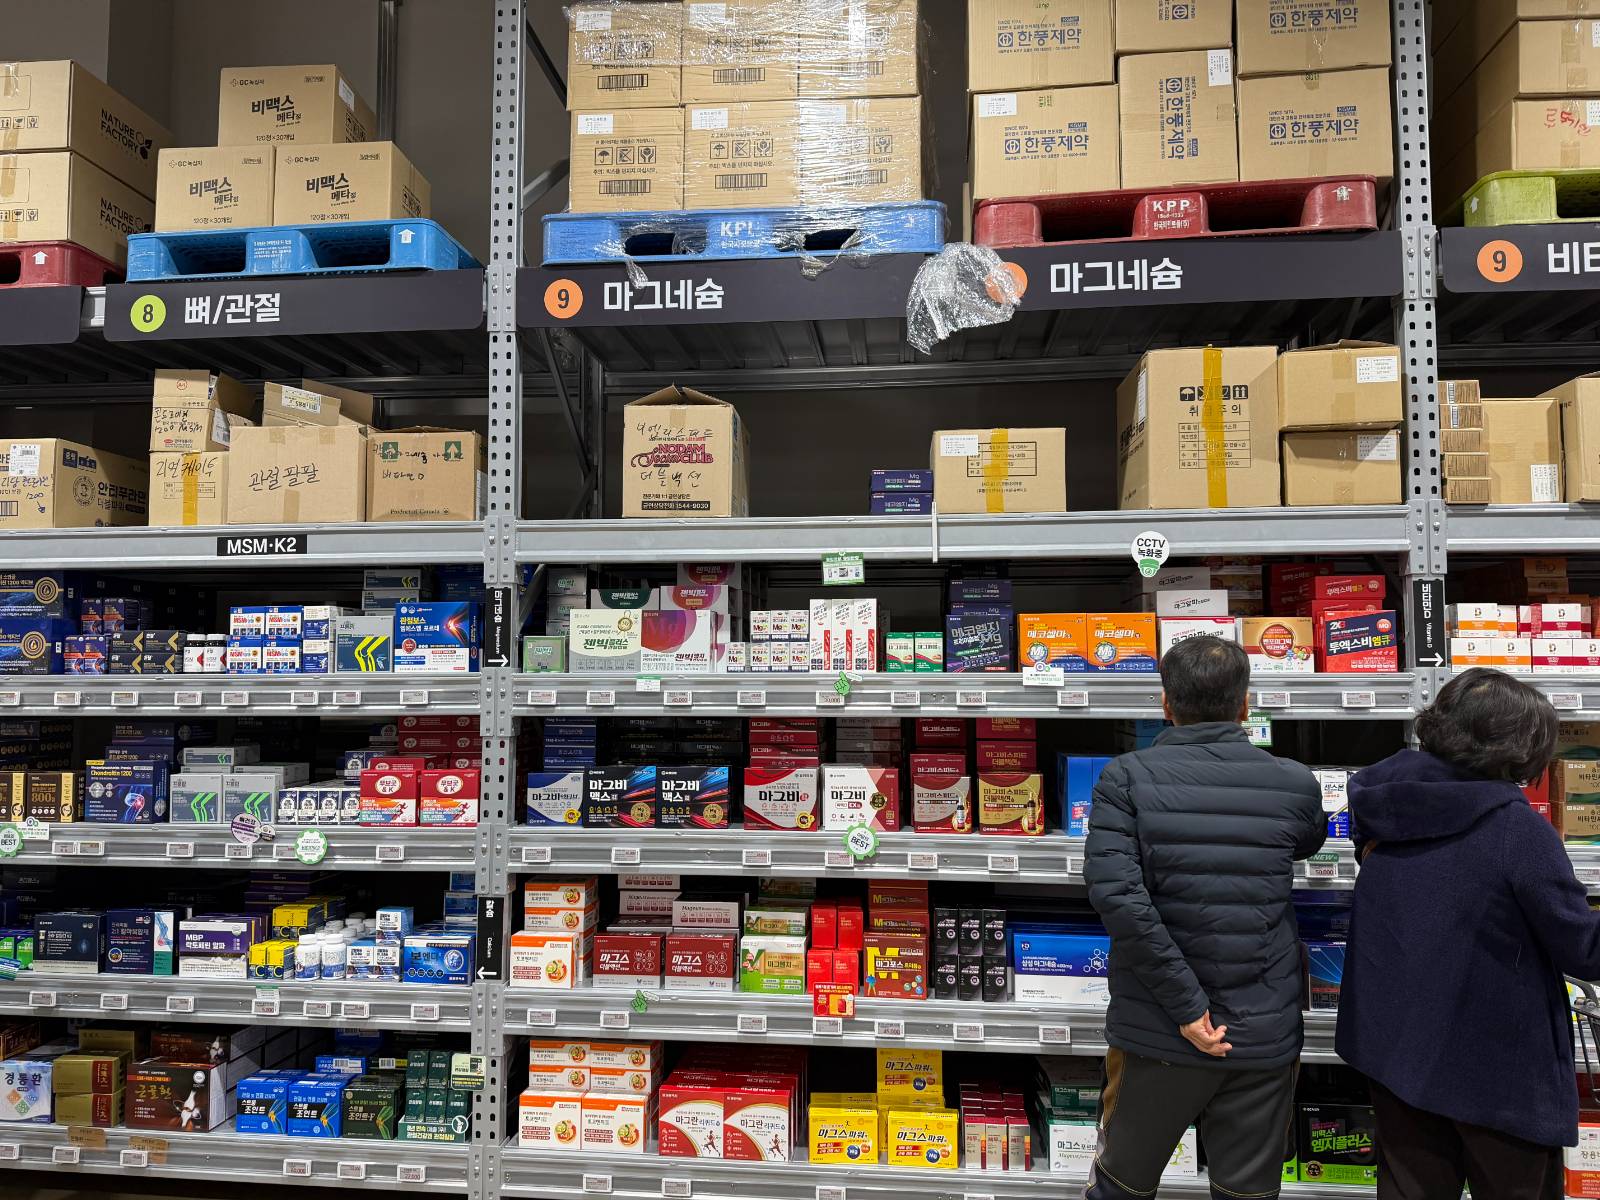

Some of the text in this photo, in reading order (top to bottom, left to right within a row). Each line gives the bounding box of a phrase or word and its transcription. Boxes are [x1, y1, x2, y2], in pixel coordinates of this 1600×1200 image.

[1290, 7, 1359, 27] 한풍제약
[1017, 28, 1082, 47] 한풍제약
[251, 94, 295, 115] 비맥스
[100, 108, 136, 138] NATURE
[1165, 96, 1185, 160] 한풍제약
[1290, 118, 1360, 139] 한풍제약
[100, 121, 140, 155] FACTORY
[1024, 134, 1089, 154] 한풍제약
[190, 176, 233, 198] 비맥스
[305, 172, 350, 194] 비맥스
[100, 196, 135, 225] NATURE
[1152, 199, 1191, 212] KPP
[1493, 250, 1507, 274] 9
[1049, 257, 1184, 295] 마그네슘
[557, 288, 571, 311] 9
[603, 277, 725, 312] 마그네슘
[141, 303, 155, 324] 8
[184, 293, 281, 325] 뼈/관절
[658, 443, 706, 454] NODAM
[1136, 537, 1166, 548] CCTV
[1137, 547, 1163, 559] 녹화중
[494, 590, 503, 623] 마그네슘
[589, 779, 629, 792] 마그비
[661, 779, 701, 792] 마그비
[589, 791, 611, 803] 맥스
[662, 791, 684, 803] 맥스
[758, 791, 800, 803] 마그비
[830, 789, 867, 800] 마그비
[0, 838, 18, 846] BEST
[850, 836, 871, 850] BEST
[185, 933, 204, 941] MBP
[599, 953, 630, 965] 마그스
[672, 954, 702, 966] 마그스
[875, 959, 904, 969] 마그포스
[244, 1105, 266, 1115] 조인트
[295, 1109, 318, 1119] 조인트
[675, 1114, 698, 1125] 마그란
[740, 1118, 763, 1129] 마그란
[1057, 1140, 1081, 1151] 마그스
[1311, 1135, 1373, 1153] 엠지플러스
